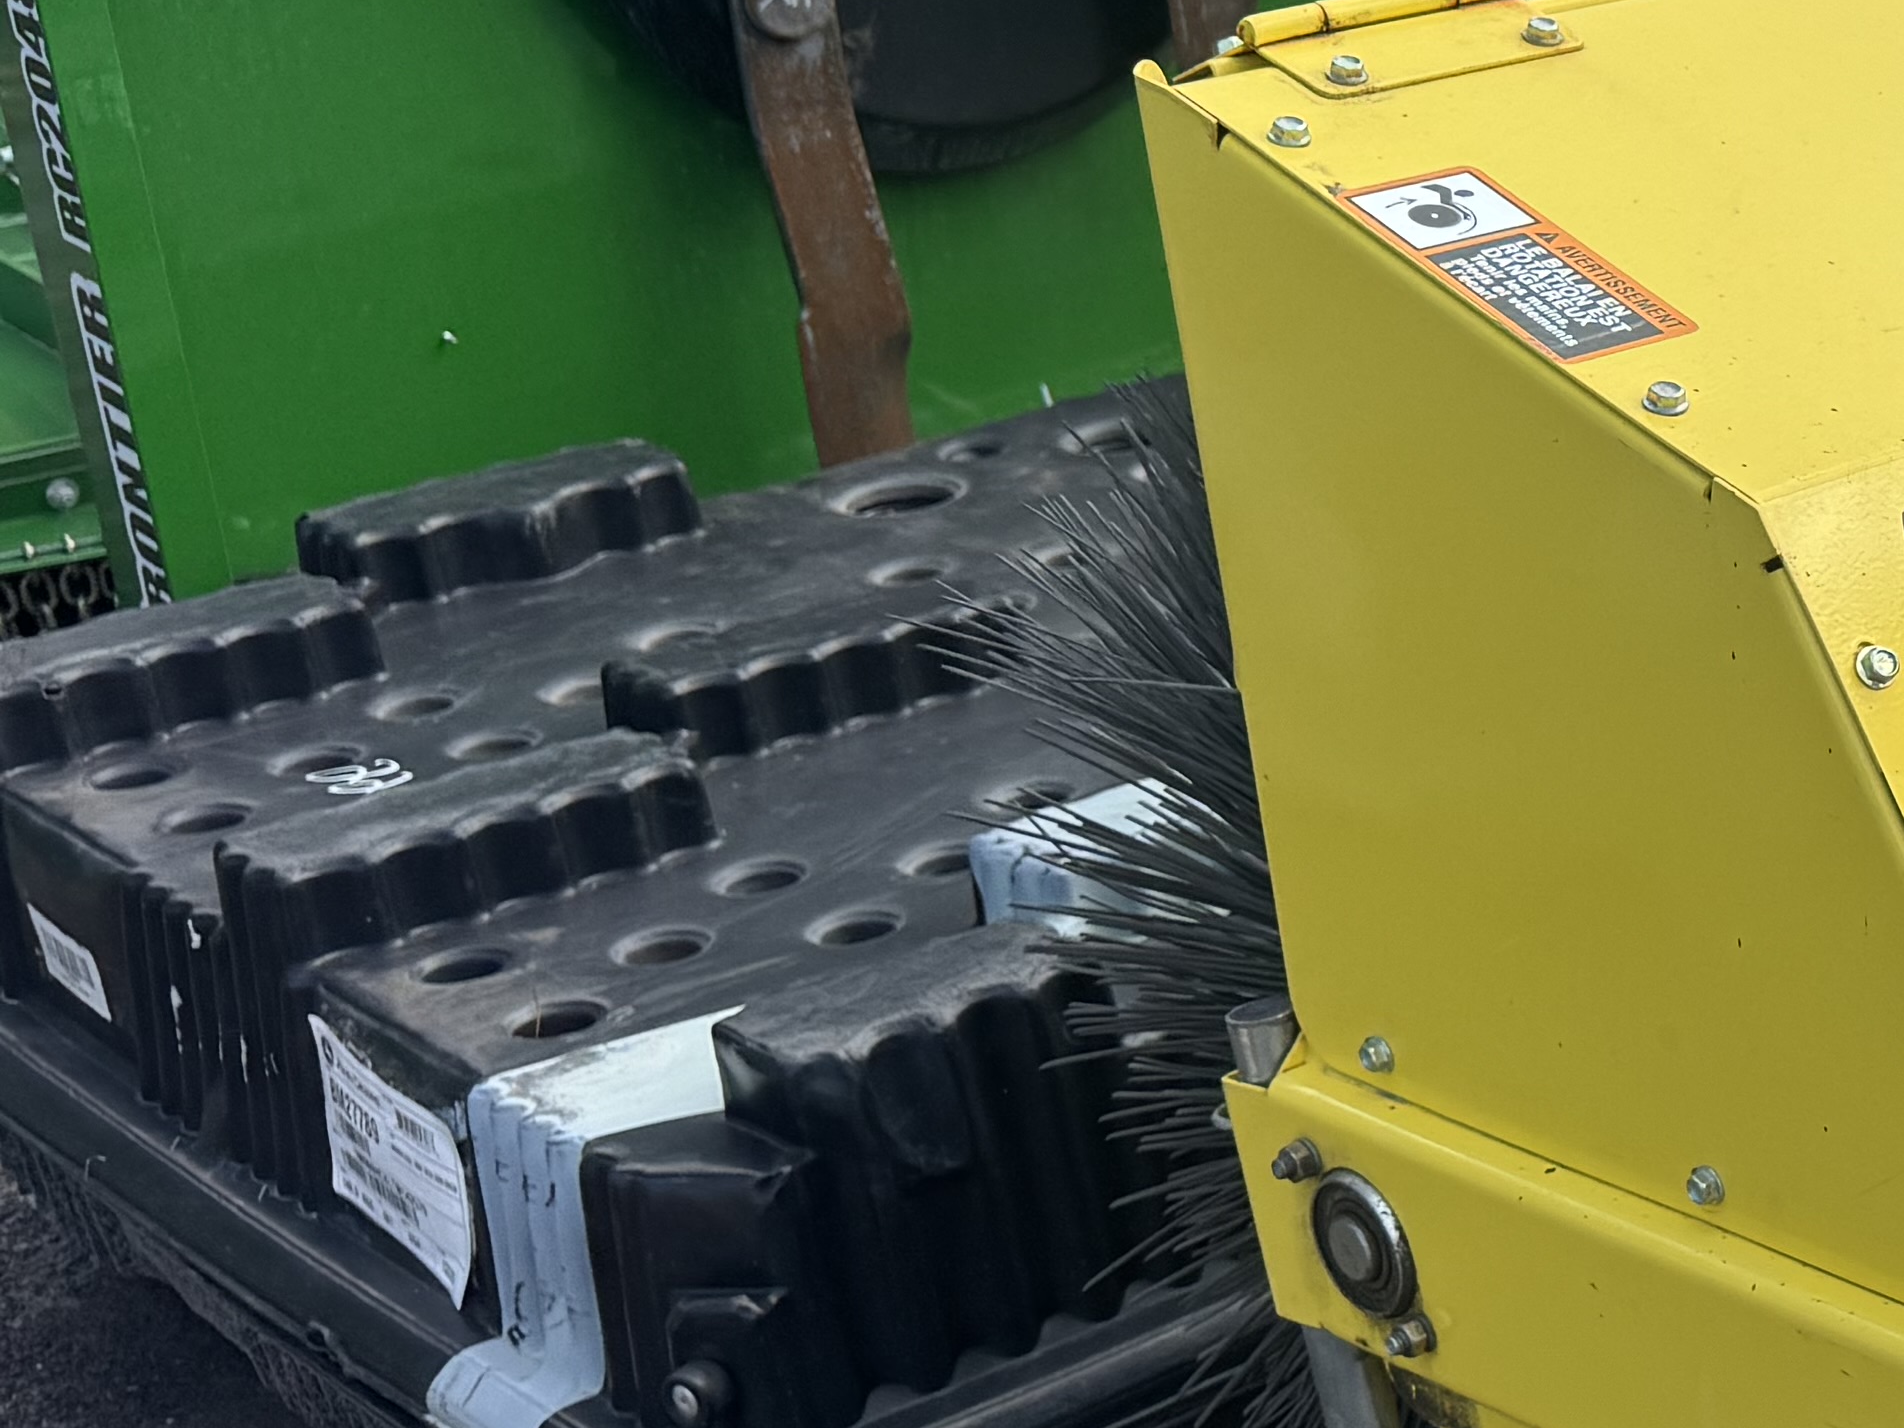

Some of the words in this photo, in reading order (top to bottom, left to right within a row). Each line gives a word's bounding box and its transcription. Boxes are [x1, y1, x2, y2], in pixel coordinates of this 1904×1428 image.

[1450, 257, 1497, 286] pieds
[1489, 284, 1513, 296] et
[1505, 296, 1582, 347] vêtements
[1467, 254, 1509, 279] Tenir
[1501, 279, 1532, 296] les
[1478, 246, 1599, 326] DANGEREUX
[1495, 243, 1594, 306] ROTATION
[1584, 306, 1633, 334] EST
[1512, 238, 1548, 257] LE
[1538, 257, 1606, 297] BALAI
[1594, 297, 1634, 317] EN
[1557, 243, 1687, 330] AVERTISSEMENT
